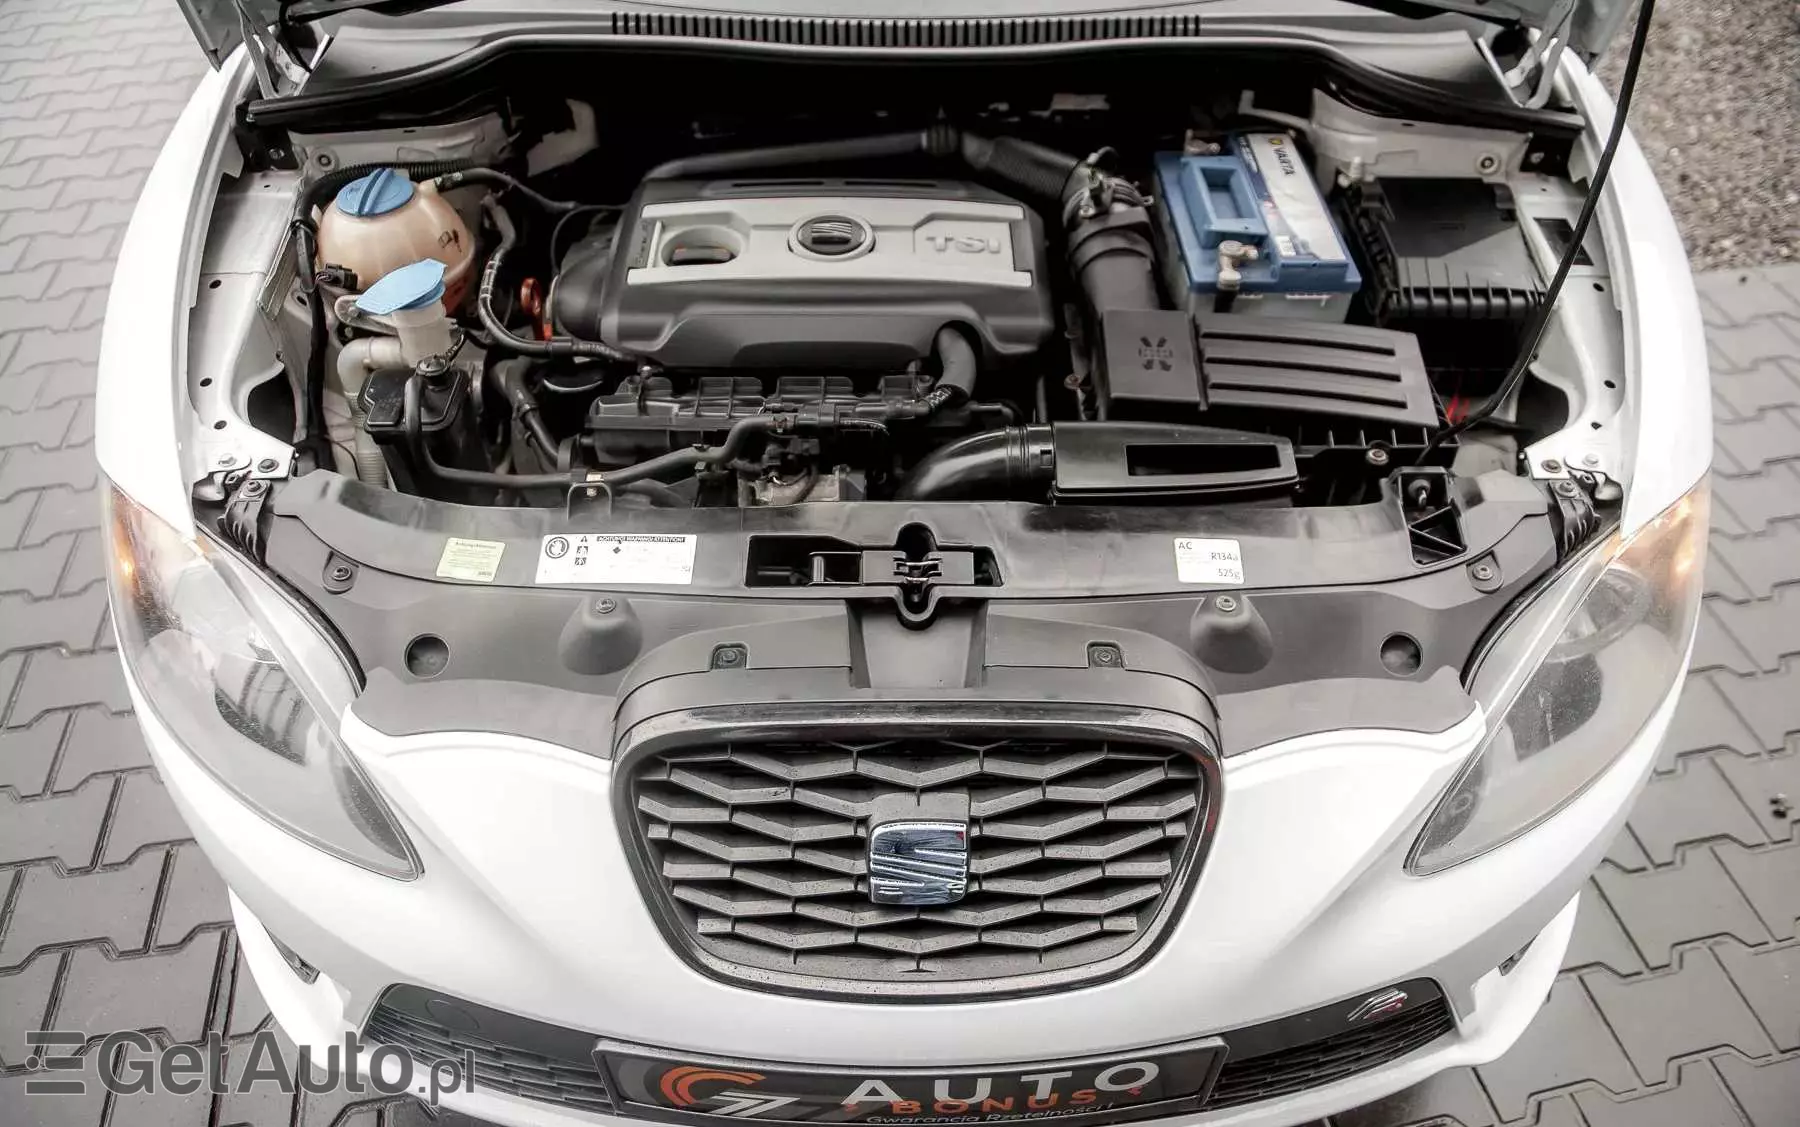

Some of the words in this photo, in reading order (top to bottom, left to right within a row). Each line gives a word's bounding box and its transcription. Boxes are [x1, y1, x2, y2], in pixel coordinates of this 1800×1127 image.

[926, 235, 1001, 254] TSI
[1179, 541, 1193, 550] AC
[841, 1061, 1160, 1105] AUTO
[889, 1089, 1097, 1114] BONUS
